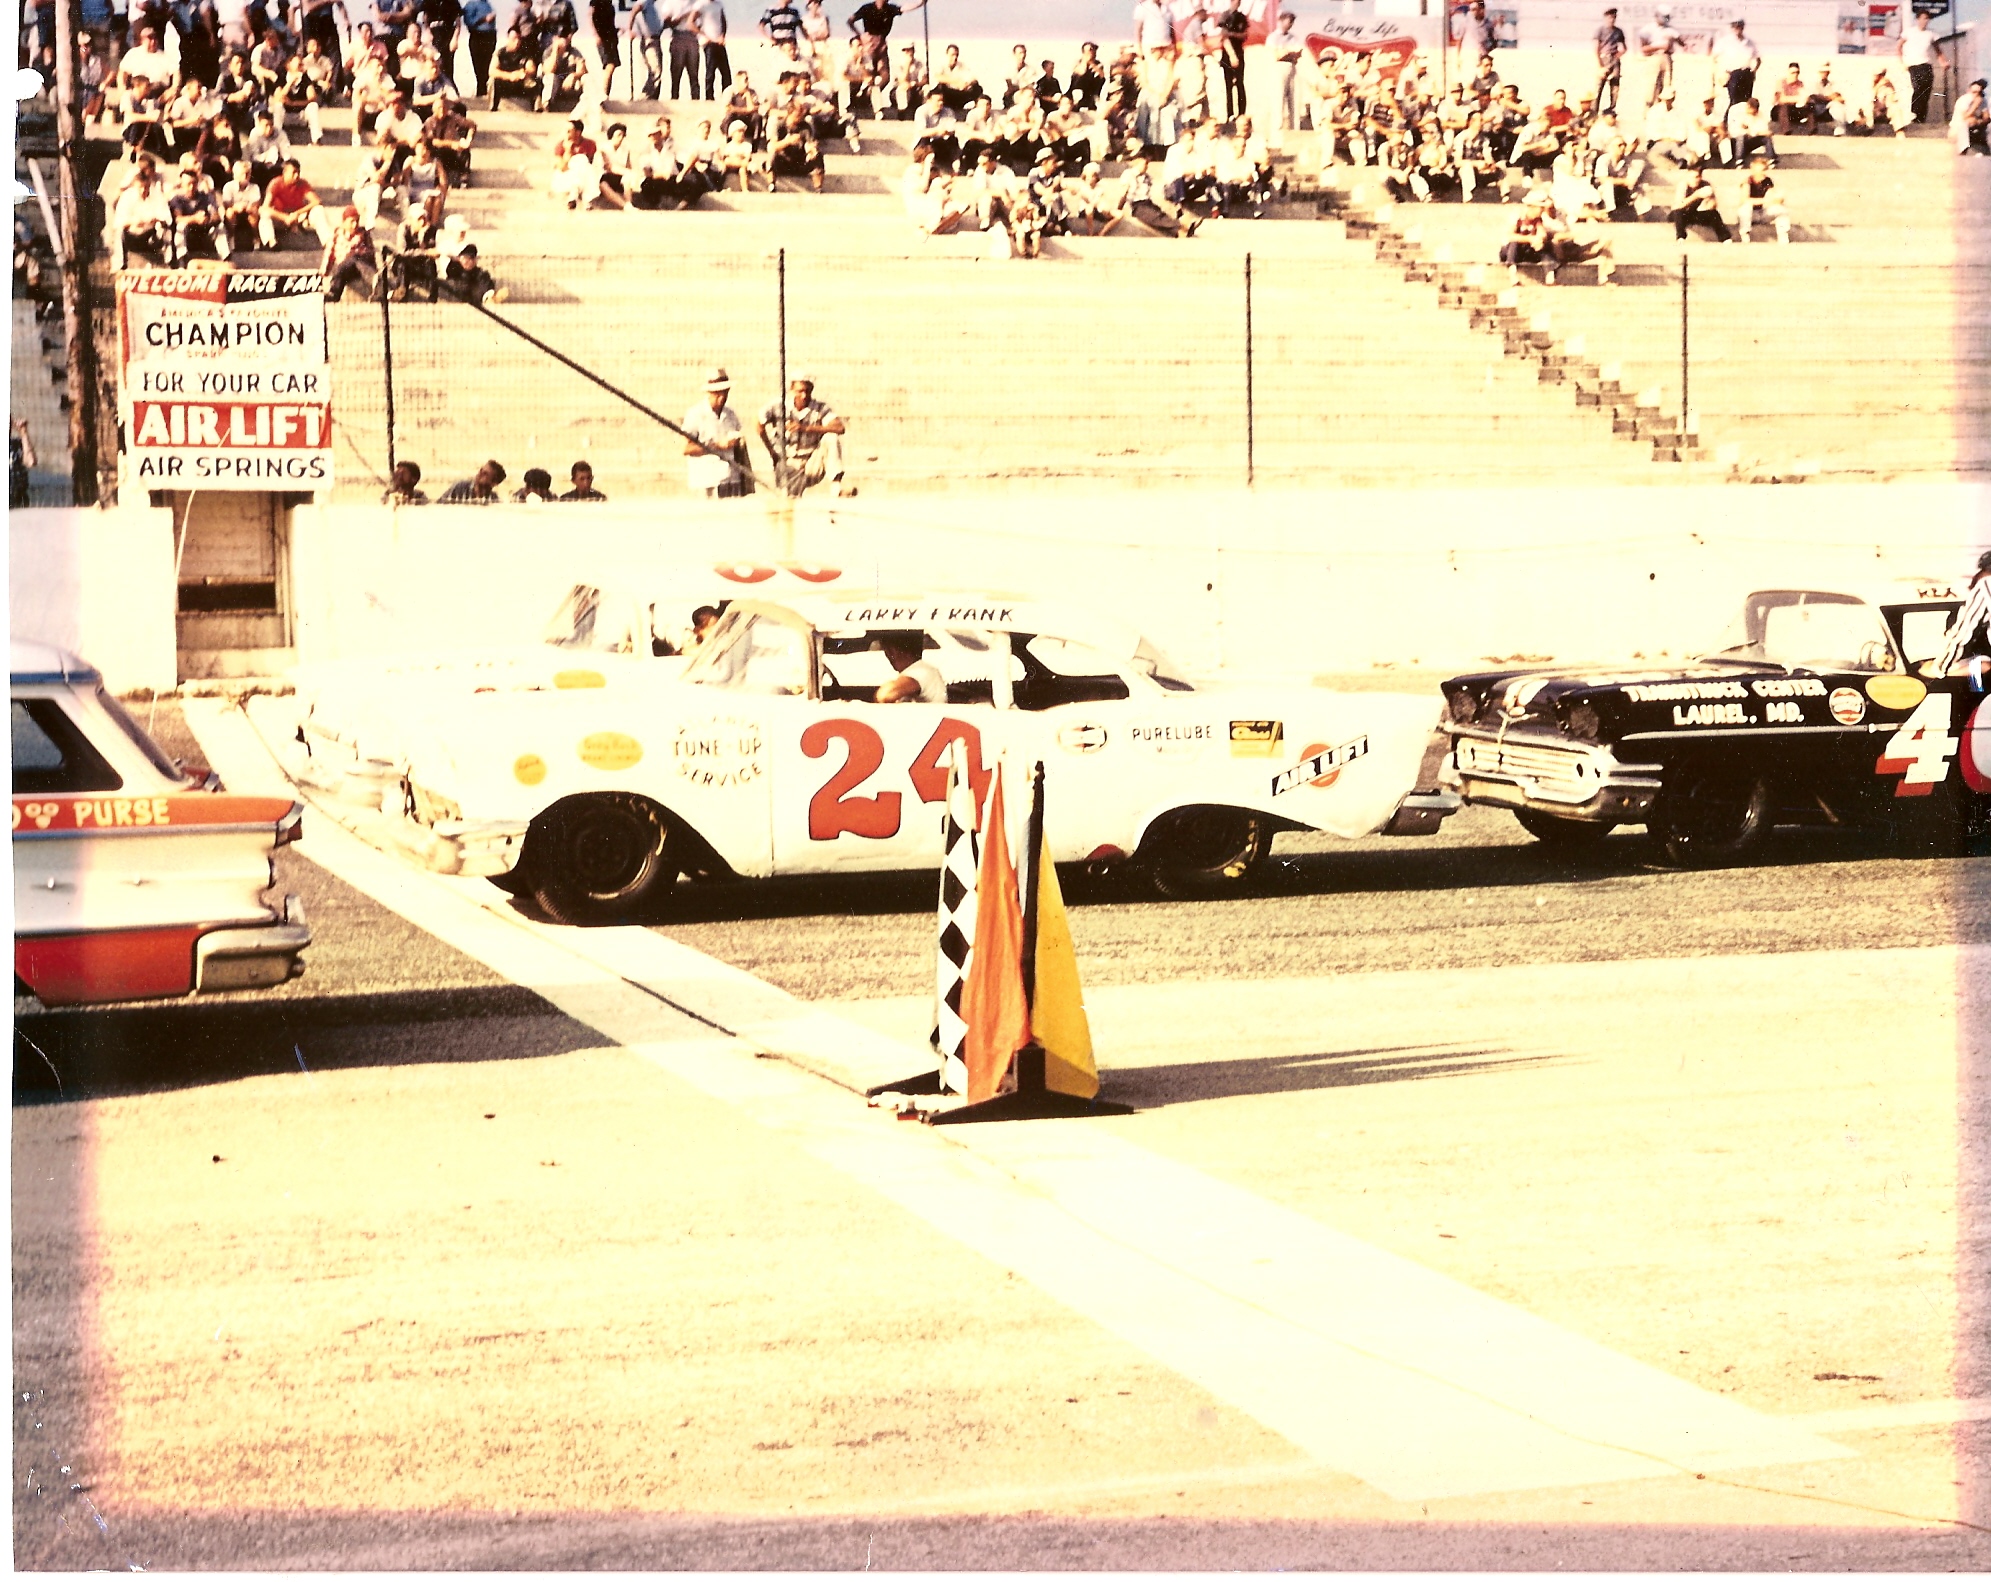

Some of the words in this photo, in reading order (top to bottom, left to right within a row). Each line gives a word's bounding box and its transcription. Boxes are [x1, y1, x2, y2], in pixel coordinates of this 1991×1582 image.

[1323, 18, 1364, 37] Enjoy
[118, 274, 223, 293] WELCOME
[228, 274, 278, 293] RACE
[145, 321, 305, 348] CHAMPION
[143, 371, 184, 393] FOR
[199, 372, 260, 395] YOUR
[271, 372, 318, 394] CAR
[137, 404, 221, 446] AIR
[230, 405, 320, 447] LIFT
[139, 456, 184, 477] AIR
[196, 456, 326, 479] SPRINGS
[845, 607, 918, 622] LARRY
[931, 607, 1015, 622] FRANK
[1751, 679, 1828, 698] CENTER
[1132, 724, 1213, 741] PURELUBE
[1884, 692, 1959, 784] 4
[677, 762, 762, 787] SERVICE
[1274, 760, 1318, 797] AIR
[1319, 735, 1367, 775] LIFT
[799, 716, 993, 841] 24
[73, 798, 171, 827] PURSE
